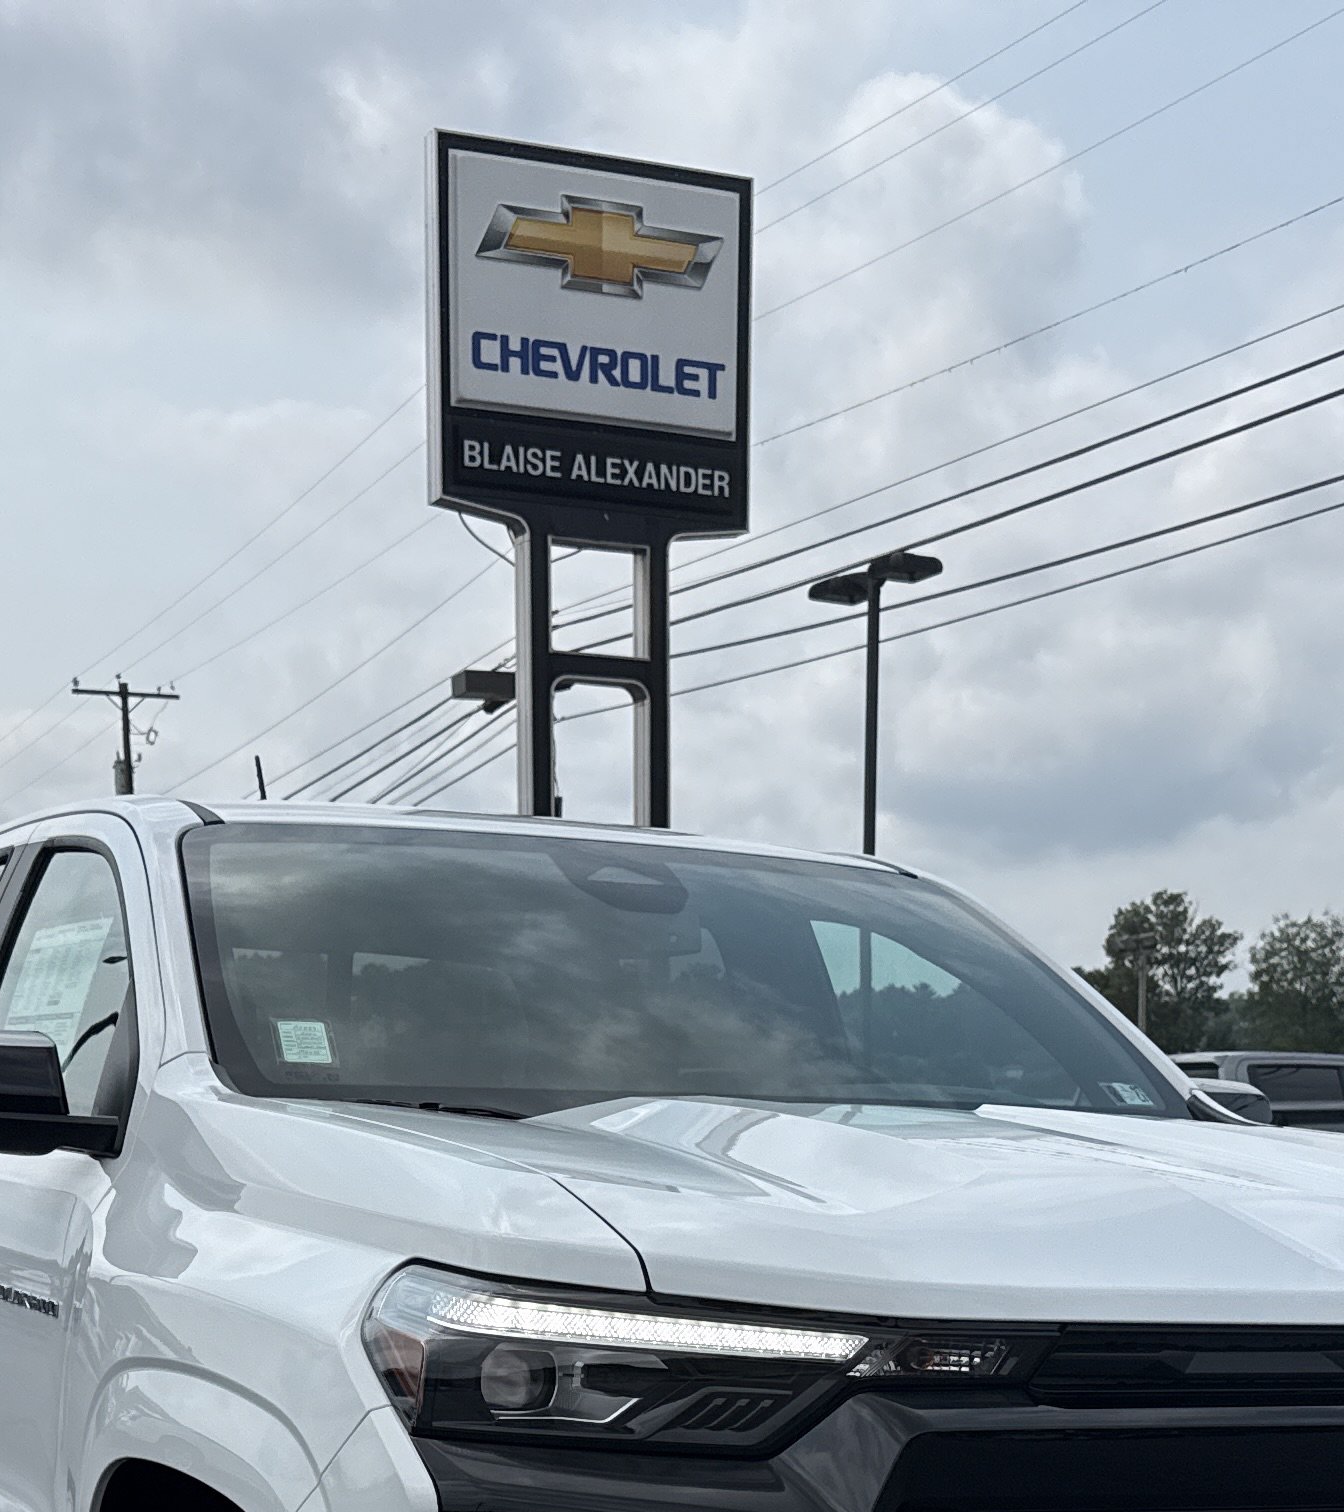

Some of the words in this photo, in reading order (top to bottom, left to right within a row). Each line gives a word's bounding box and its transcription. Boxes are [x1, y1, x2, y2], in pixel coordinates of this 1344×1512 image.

[471, 330, 726, 400] CHEVROLET
[462, 439, 562, 478] BLAISE
[570, 453, 730, 498] ALEXANDER
